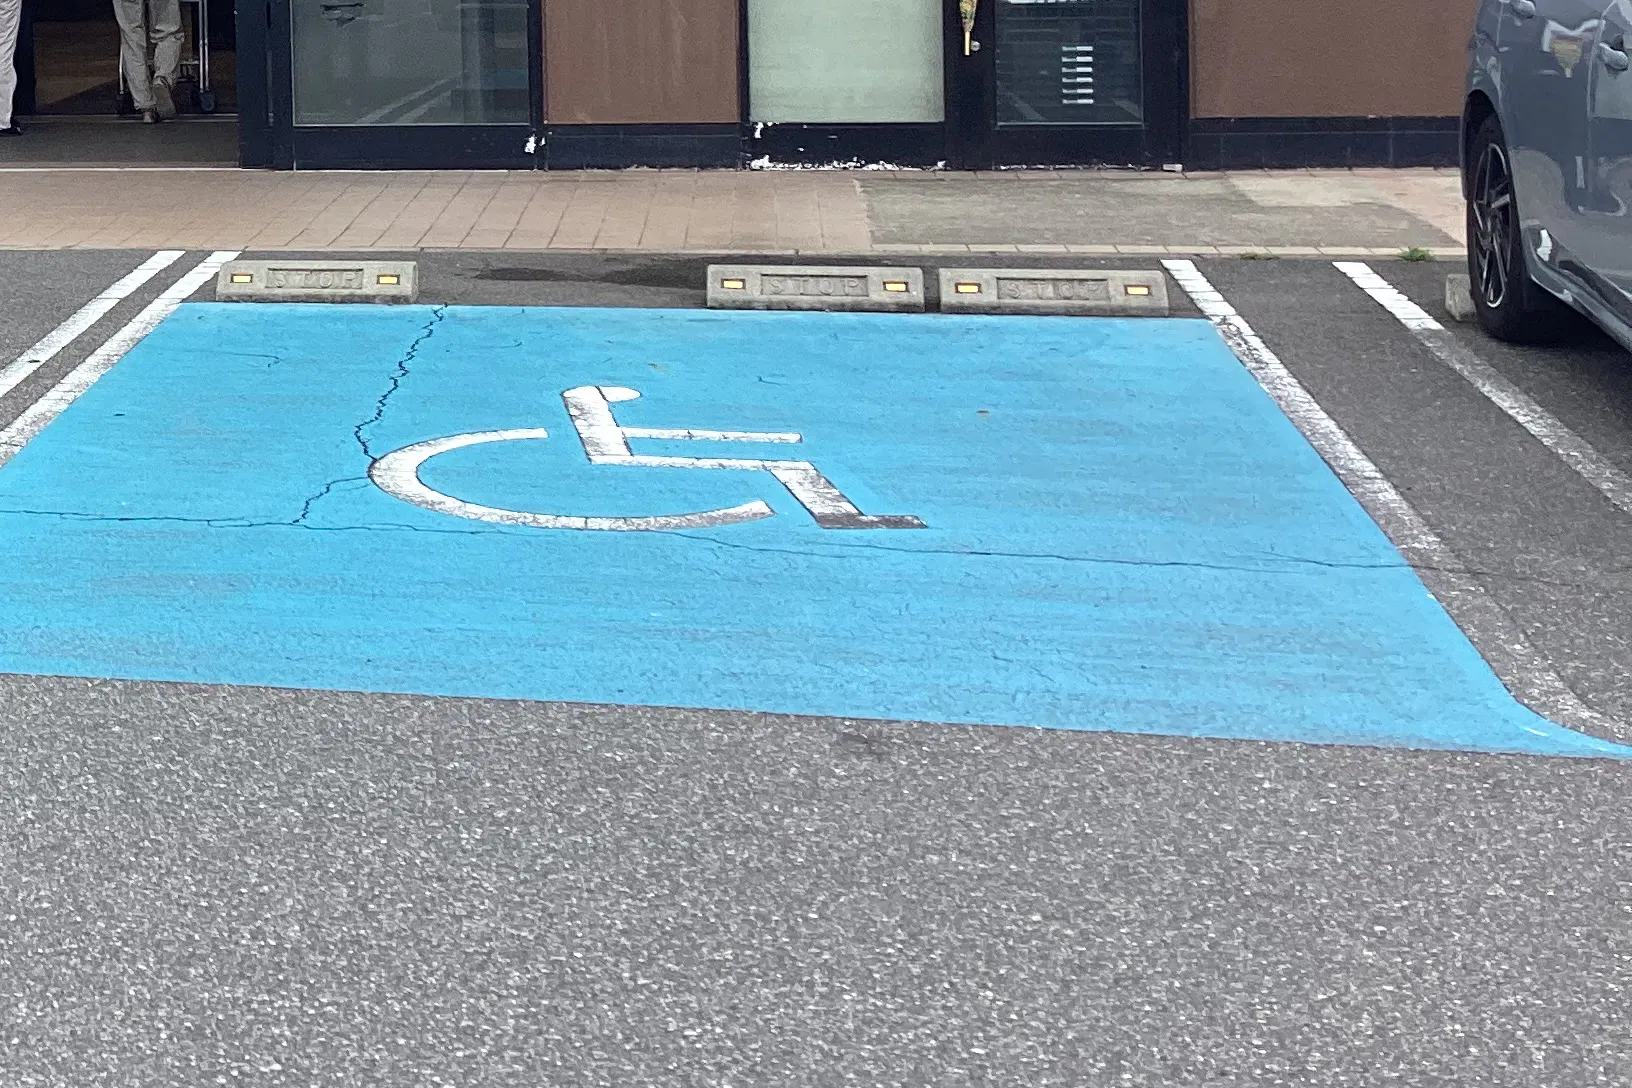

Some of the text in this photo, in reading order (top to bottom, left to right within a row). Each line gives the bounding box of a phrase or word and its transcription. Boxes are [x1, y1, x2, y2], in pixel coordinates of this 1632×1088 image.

[275, 271, 357, 288] STOP
[769, 278, 859, 296] STOP
[1006, 279, 1101, 299] STOP
